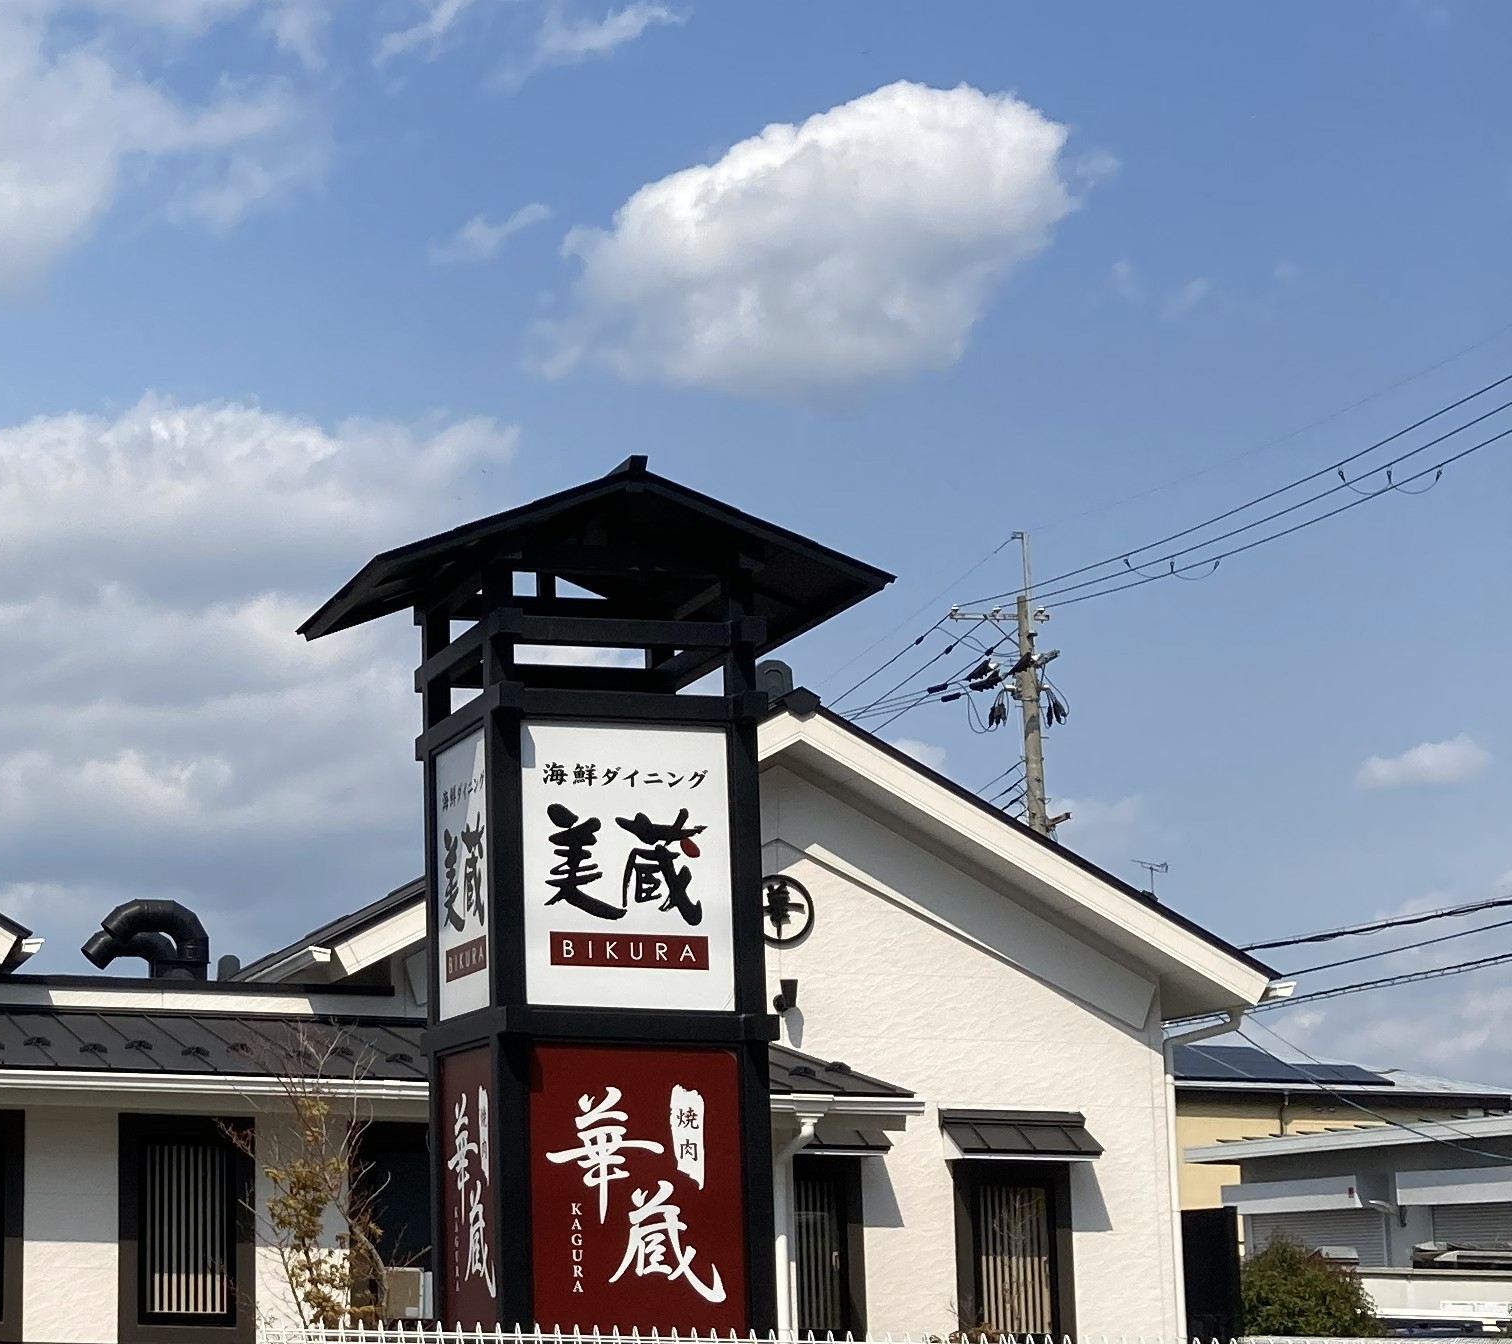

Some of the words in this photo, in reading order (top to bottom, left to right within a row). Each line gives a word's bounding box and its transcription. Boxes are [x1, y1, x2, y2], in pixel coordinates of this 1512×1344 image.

[441, 771, 485, 811] 海鮮ダイニング
[542, 762, 708, 789] 海鮮ダイニング
[443, 811, 485, 932] 美蔵
[544, 803, 707, 926] 美蔵
[448, 949, 485, 974] BIKURA
[562, 940, 697, 962] BIKURA
[676, 1107, 699, 1161] 焼肉
[447, 1093, 497, 1298] 華蔵
[546, 1086, 727, 1303] 華蔵
[571, 1202, 584, 1293] KAGURA
